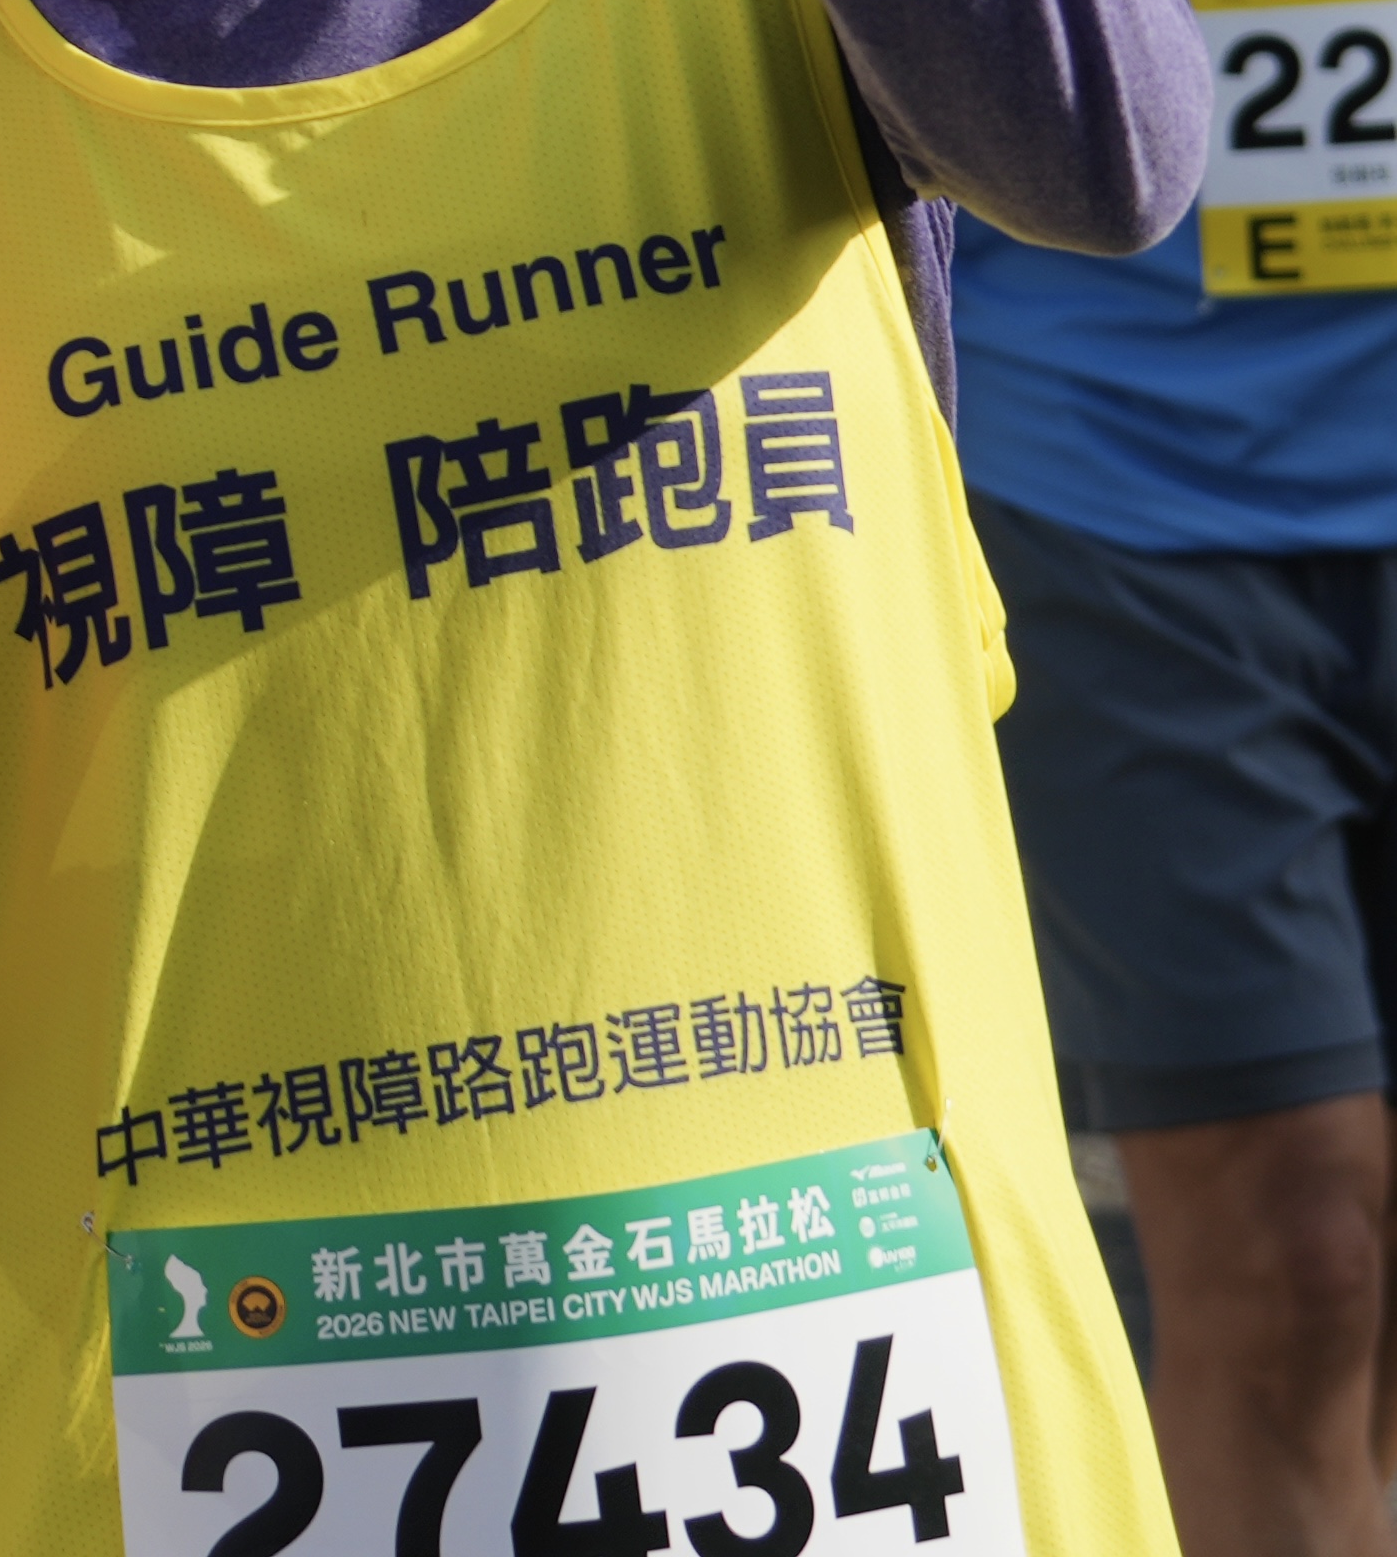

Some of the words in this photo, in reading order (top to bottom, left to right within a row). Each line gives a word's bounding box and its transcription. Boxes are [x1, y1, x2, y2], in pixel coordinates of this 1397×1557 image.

[1220, 26, 1397, 152] 22
[47, 301, 340, 418] Guide
[366, 222, 727, 355] Runner
[1248, 212, 1301, 282] E
[385, 369, 854, 599] 陪跑員
[94, 975, 907, 1187] 中華視障路跑運動協會
[310, 1184, 837, 1303] 新北市萬金石馬拉松
[316, 1311, 385, 1341] 2026
[388, 1305, 457, 1335] NEW
[463, 1296, 556, 1329] TAIPEI
[562, 1287, 627, 1320] CITY
[631, 1278, 695, 1312] WJS
[698, 1248, 842, 1300] MARATHON
[180, 1332, 965, 1557] 27434
